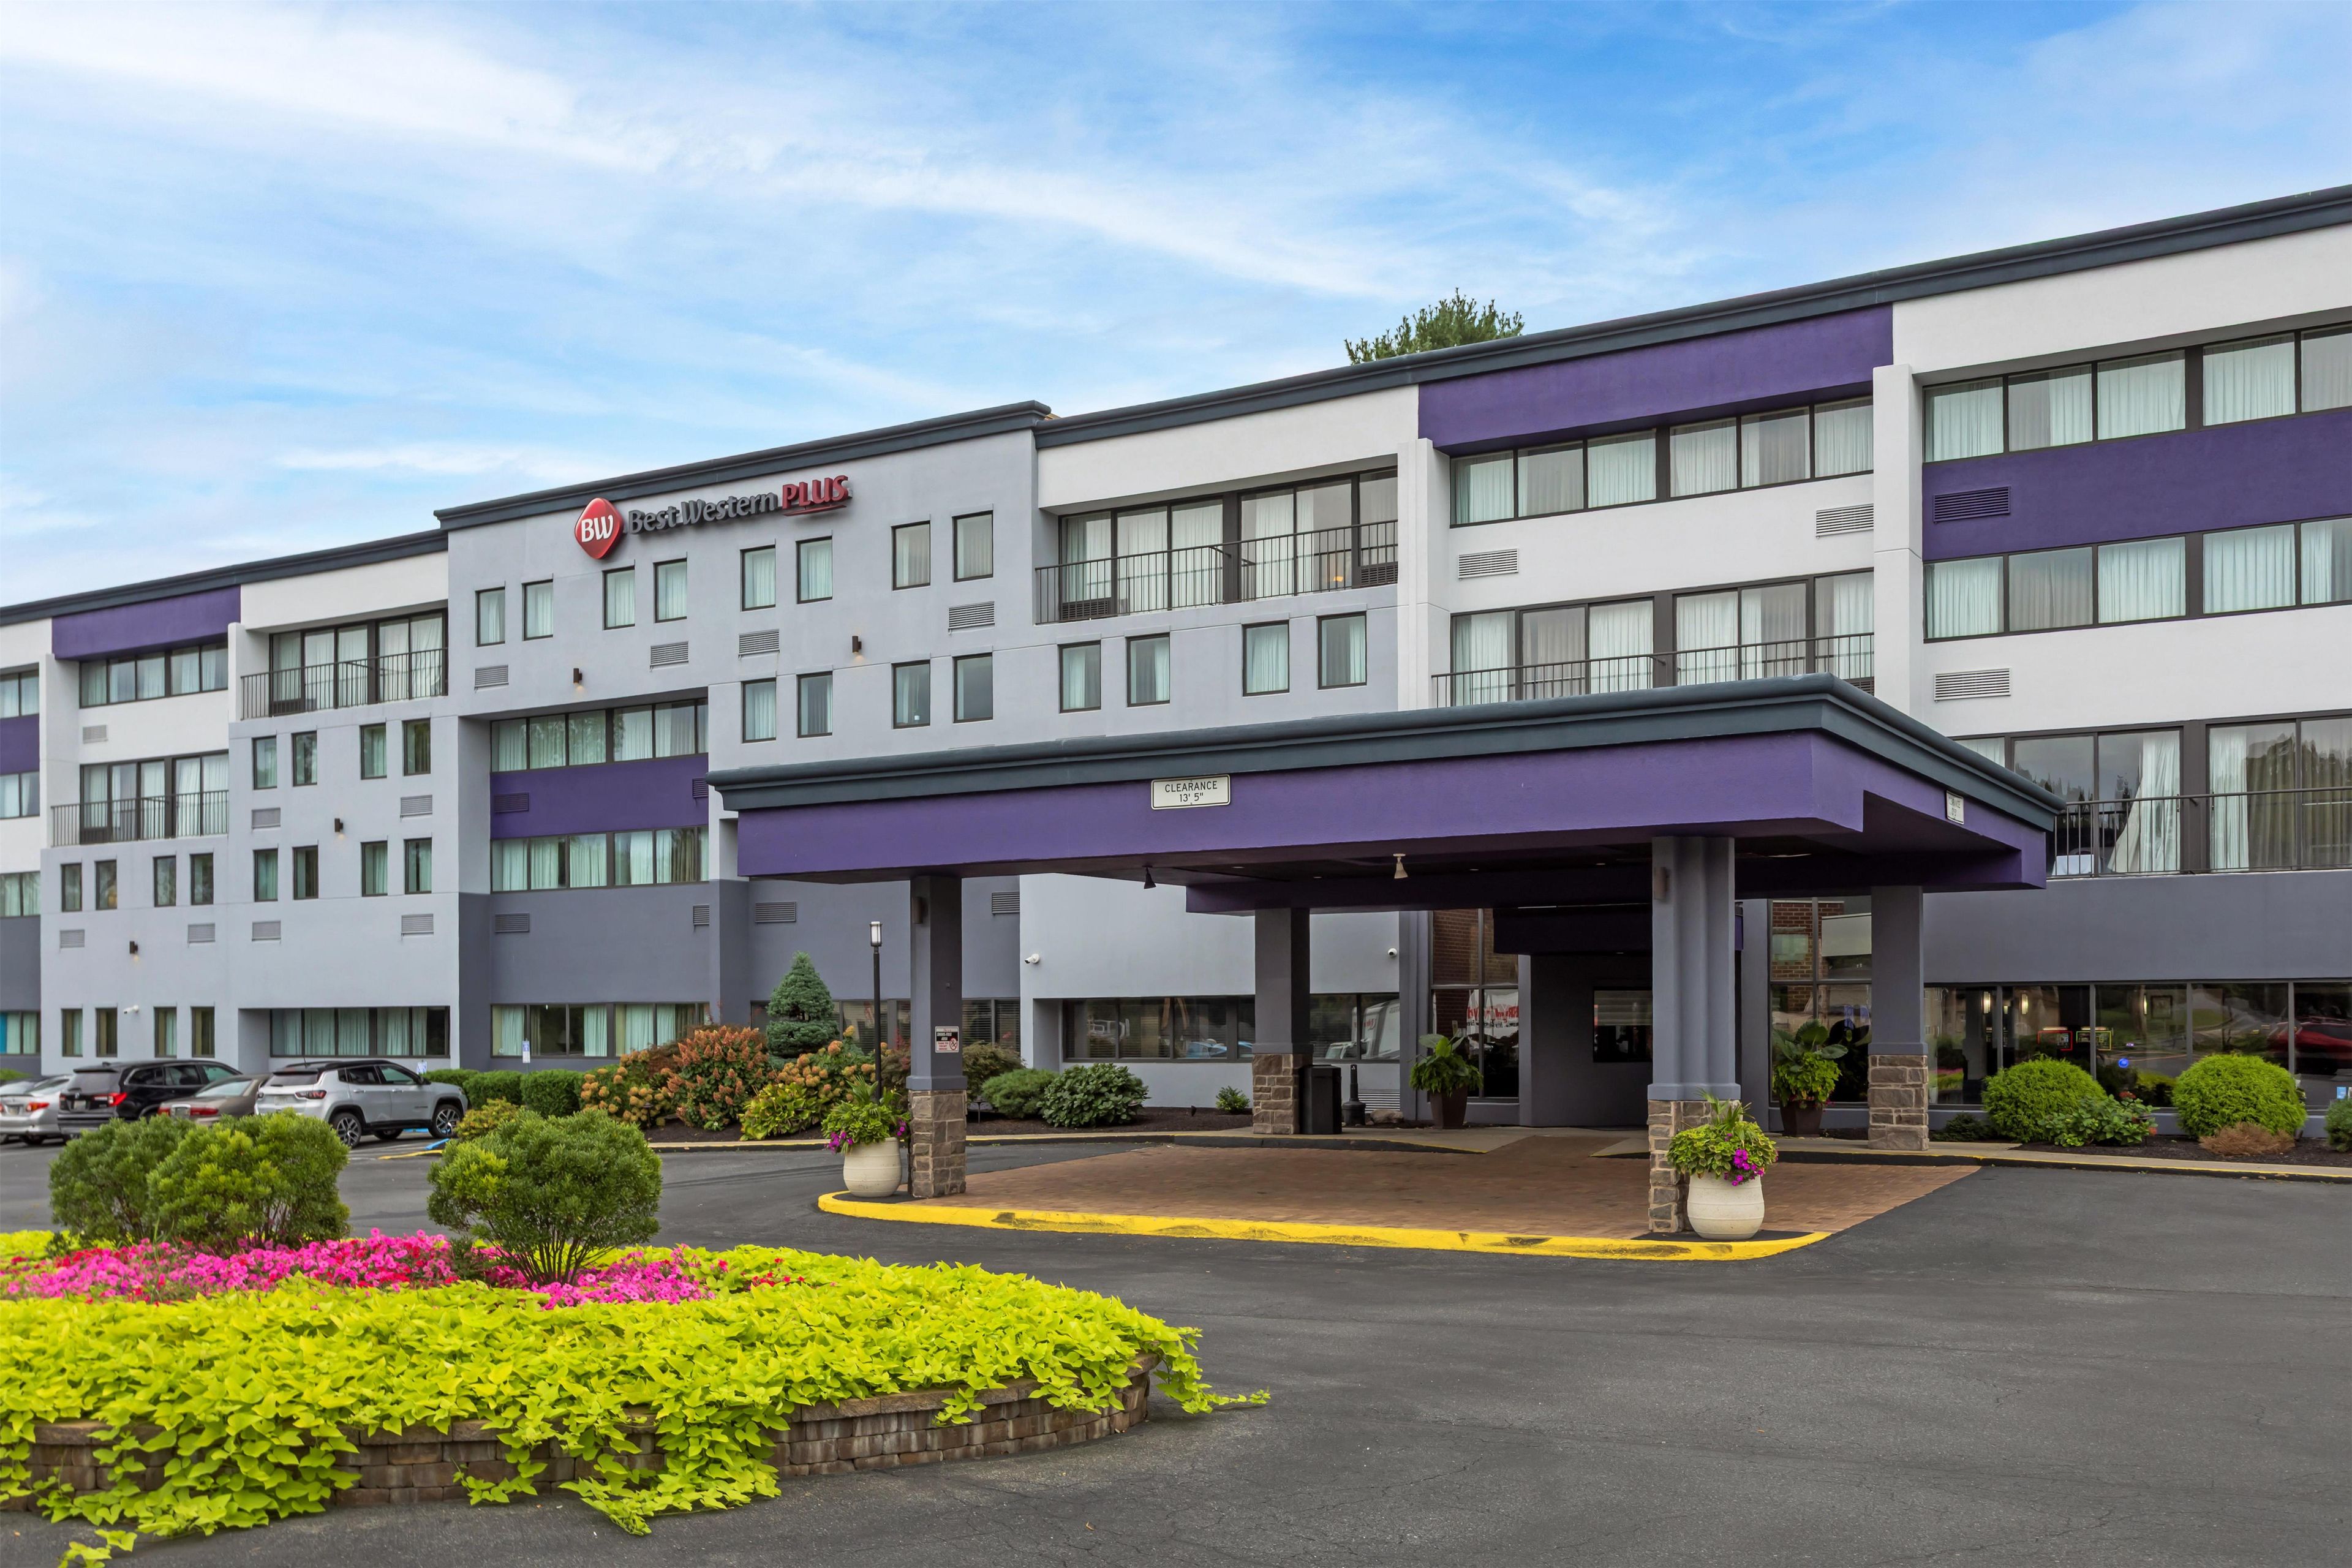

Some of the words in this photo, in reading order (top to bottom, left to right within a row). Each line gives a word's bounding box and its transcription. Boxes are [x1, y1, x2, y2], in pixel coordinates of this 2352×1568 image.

[628, 506, 680, 535] Best
[681, 492, 778, 525] Western
[782, 475, 848, 510] PLUS
[581, 514, 613, 542] BW
[1164, 780, 1218, 793] CLEARANCE
[1179, 793, 1191, 802] 13'
[1194, 792, 1204, 802] 5"
